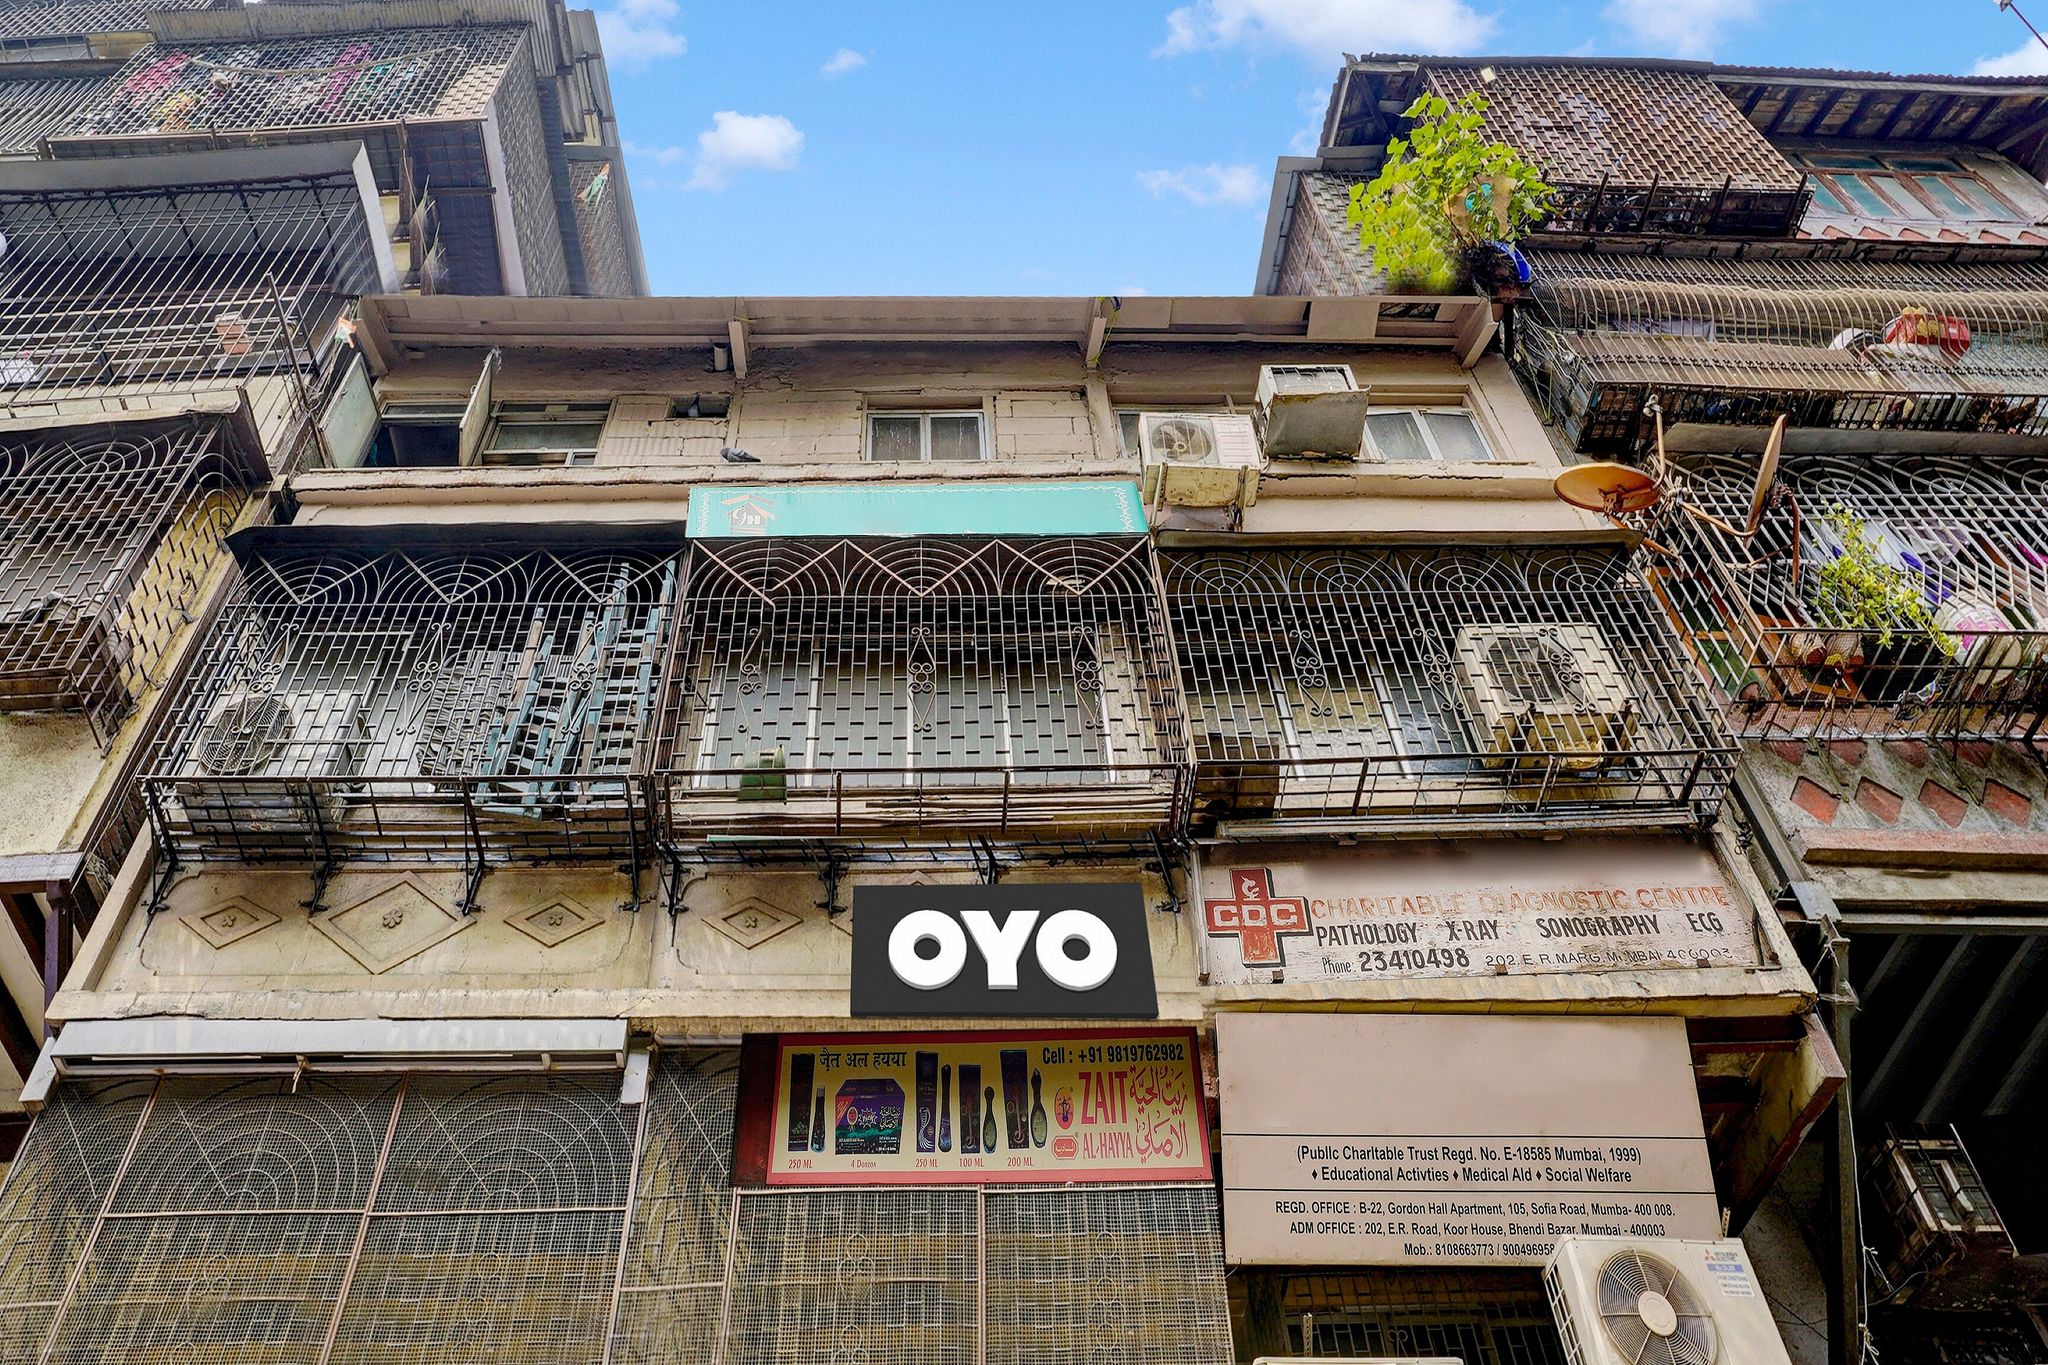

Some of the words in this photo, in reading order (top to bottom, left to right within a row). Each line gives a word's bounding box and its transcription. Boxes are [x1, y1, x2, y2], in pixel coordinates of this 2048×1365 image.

[1311, 894, 1463, 920] CHARITABLE
[1479, 889, 1633, 914] DIAGNOSTIC
[1637, 886, 1732, 909] CENTRE
[1213, 903, 1298, 927] CDC
[1316, 922, 1417, 947] PATHOLOGY
[1445, 919, 1499, 941] X-RAY
[1535, 914, 1661, 939] SONOGRAPHY
[1686, 911, 1724, 934] ECG
[888, 909, 1118, 991] OYO
[1359, 947, 1470, 972] 23410498
[845, 1052, 869, 1068] अल
[1042, 1046, 1065, 1065] Cell
[1078, 1046, 1102, 1063] +91
[1107, 1043, 1184, 1062] 9819762982
[1078, 1071, 1128, 1124] ZAIT
[788, 1159, 801, 1169] 250
[803, 1159, 813, 1169] ML
[915, 1158, 928, 1168] 250
[929, 1158, 938, 1168] ML
[959, 1158, 972, 1168] 100
[974, 1158, 984, 1168] ML
[1007, 1157, 1021, 1167] 200
[1023, 1157, 1034, 1167] ML
[1407, 1146, 1439, 1160] Trust
[1441, 1146, 1477, 1164] Regd.
[1479, 1146, 1501, 1161] No.
[1503, 1146, 1551, 1161] E-18585
[1554, 1146, 1606, 1164] Mumbai,
[1609, 1147, 1641, 1166] 1999)
[1321, 1166, 1393, 1181] Educational
[1396, 1166, 1449, 1181] Activties
[1462, 1166, 1509, 1182] Medical
[1545, 1167, 1581, 1182] Social
[1585, 1167, 1632, 1183] Welfare
[1275, 1200, 1309, 1214] REGD.
[1312, 1201, 1350, 1214] OFFICE
[1359, 1201, 1386, 1216] B-22,
[1387, 1202, 1426, 1215] Gordon
[1428, 1202, 1448, 1215] Hall
[1450, 1202, 1506, 1217] Apartment,
[1508, 1202, 1529, 1217] 105,
[1531, 1202, 1557, 1215] Sofia
[1559, 1202, 1589, 1217] Road,
[1634, 1203, 1652, 1216] 400
[1654, 1203, 1676, 1216] 008.
[1290, 1221, 1314, 1234] ADM
[1317, 1221, 1355, 1235] OFFICE
[1364, 1222, 1386, 1236] 202,
[1388, 1222, 1409, 1235] E.R.
[1411, 1222, 1441, 1237] Road,
[1443, 1222, 1468, 1235] Koor
[1471, 1222, 1506, 1237] House,
[1508, 1223, 1545, 1236] Bhendi
[1580, 1223, 1621, 1236] Mumbai
[1630, 1223, 1666, 1237] 400003
[1435, 1243, 1494, 1256] 8108663773
